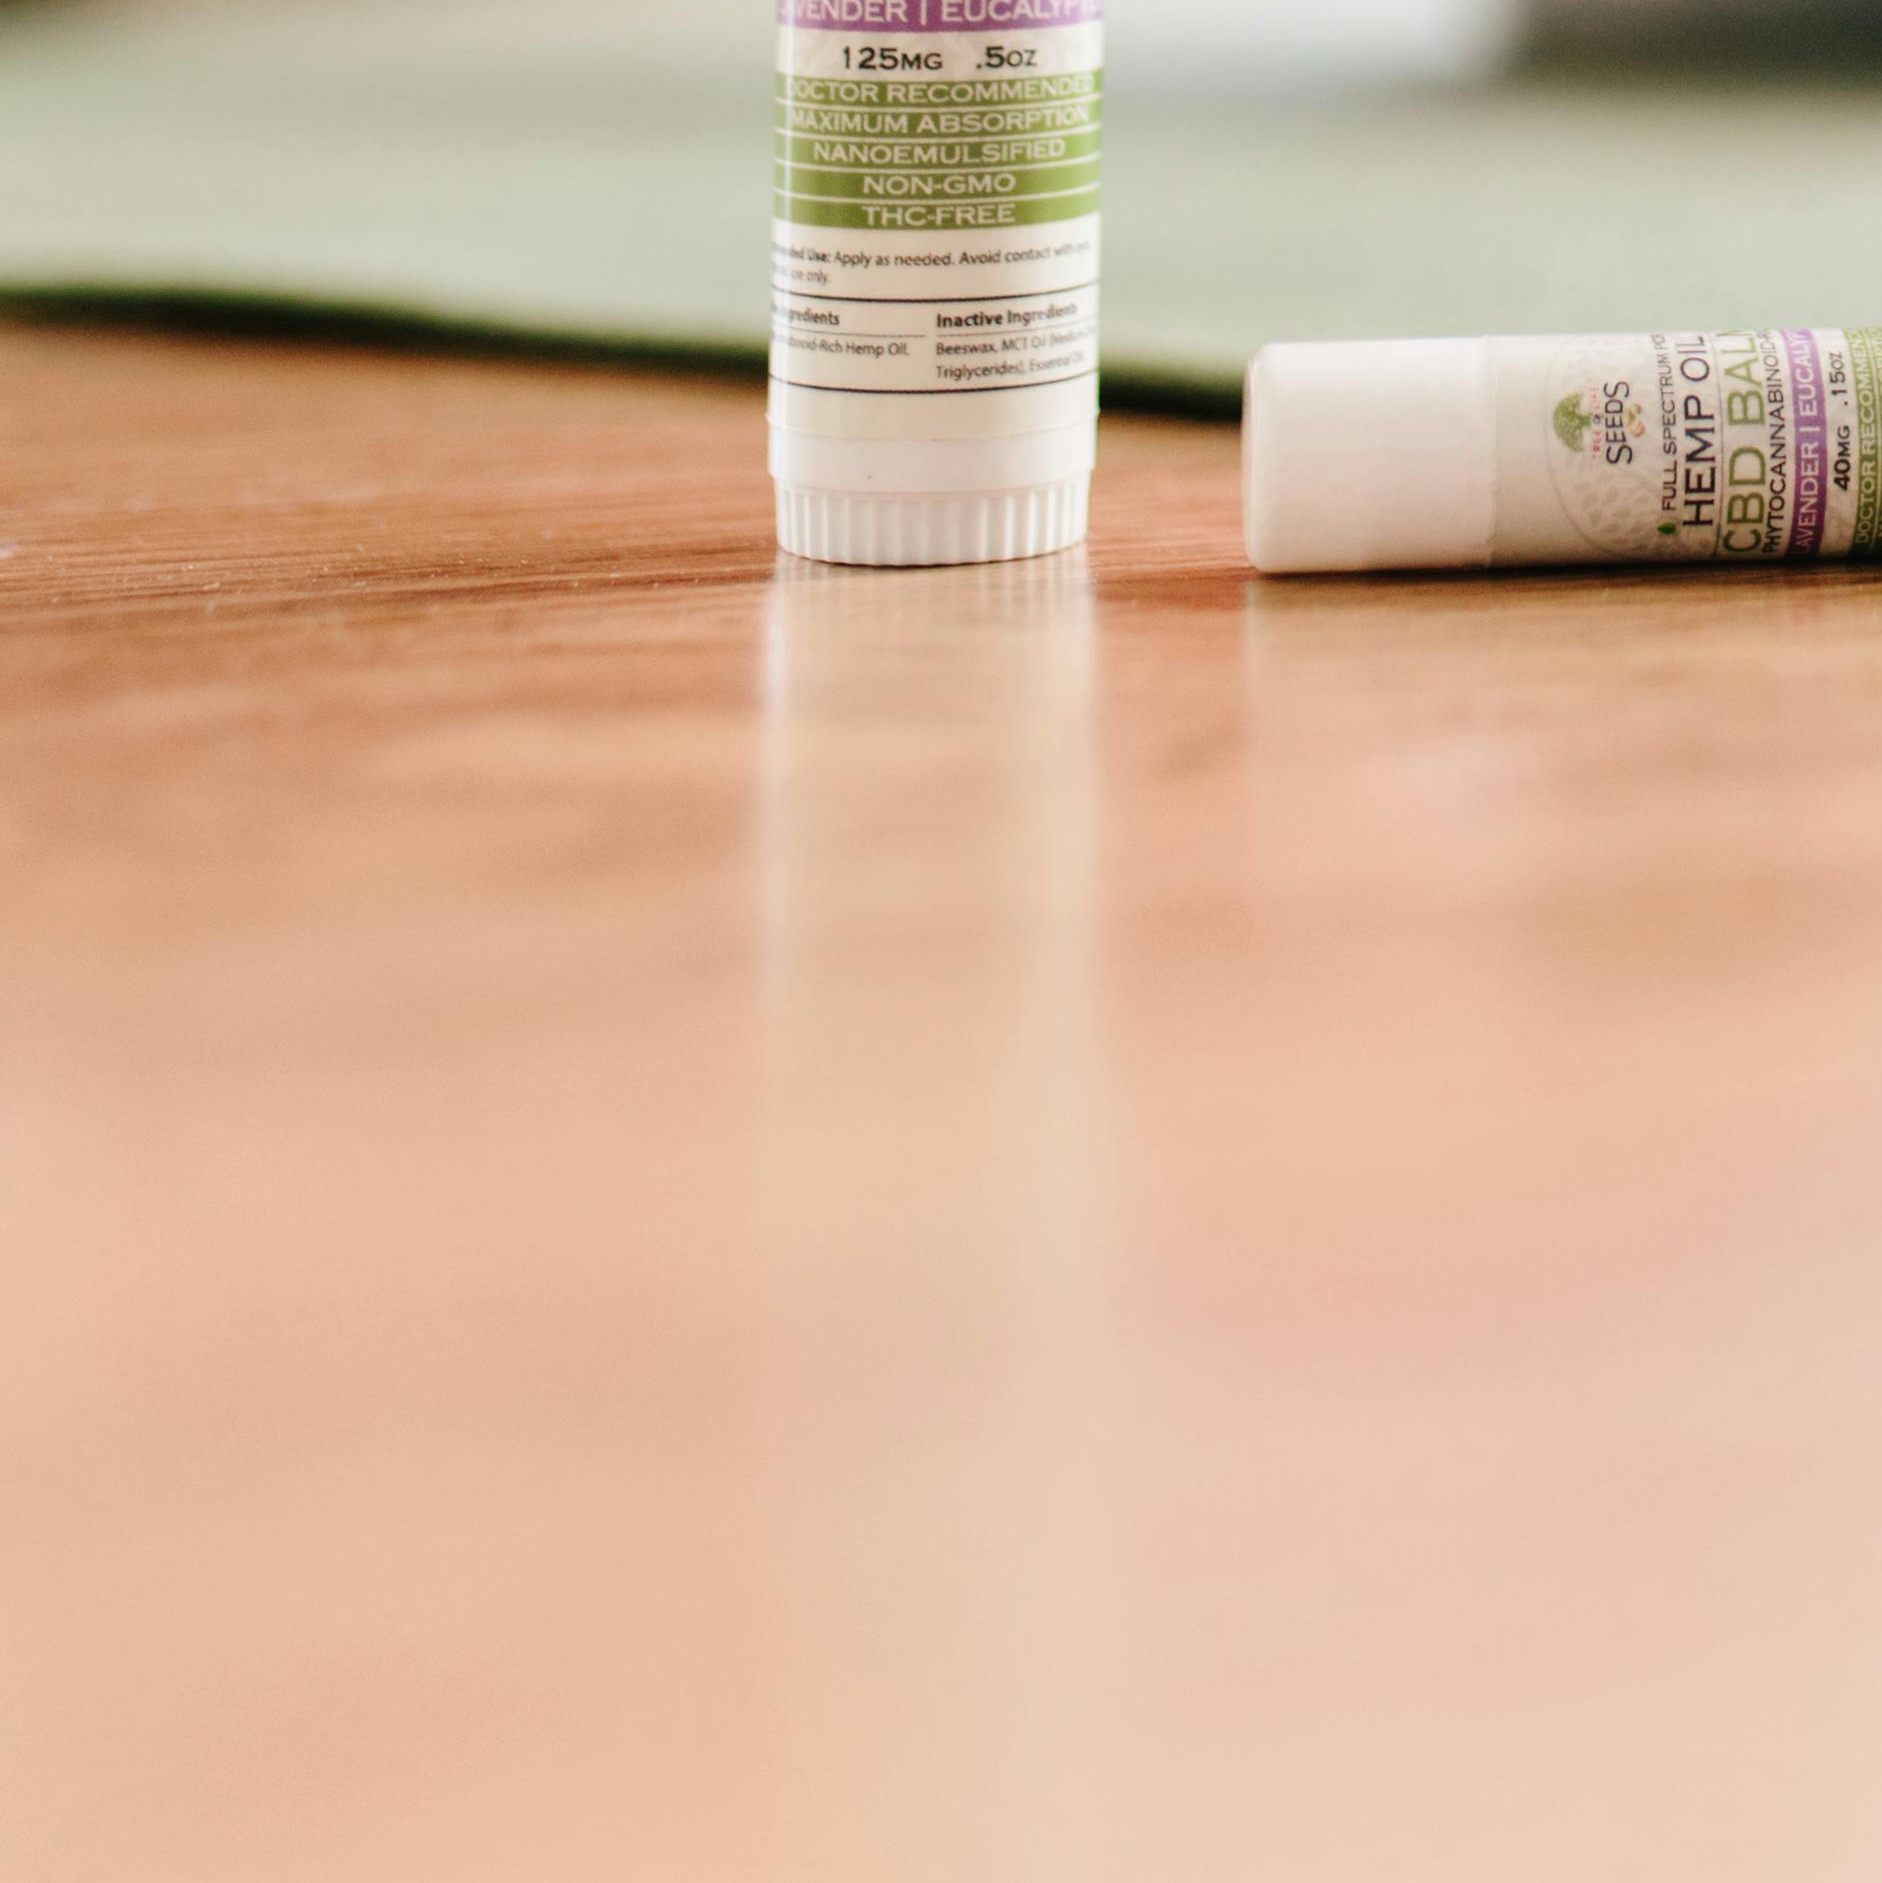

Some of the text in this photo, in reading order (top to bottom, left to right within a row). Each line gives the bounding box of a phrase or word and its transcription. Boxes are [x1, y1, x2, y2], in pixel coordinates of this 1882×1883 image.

[788, 77, 879, 104] DOCTOR
[791, 103, 1090, 134] MAXIMUM ABSORPTION
[813, 137, 1066, 165] NANOEMULSIFIED
[863, 172, 1017, 196] NON-GMO
[862, 202, 1016, 227] THC-FREE
[834, 250, 872, 268] Apply
[875, 254, 890, 266] as
[895, 250, 954, 267] needed.
[959, 246, 1001, 265] Avoid
[1005, 242, 1052, 262] contact
[936, 309, 1003, 329] Inactive
[846, 340, 885, 359] Hemp
[936, 341, 999, 358] Beeswax,
[1656, 352, 1677, 455] SPECTRUM
[1603, 381, 1633, 465] SEEDS
[1677, 335, 1716, 526] HEMP OIL
[1833, 426, 1851, 491] 40MG
[1661, 460, 1677, 511] FULL
[1722, 445, 1767, 554] CBD
[1794, 441, 1820, 555] LAVENDER
[1855, 461, 1876, 544] DOCTOR
